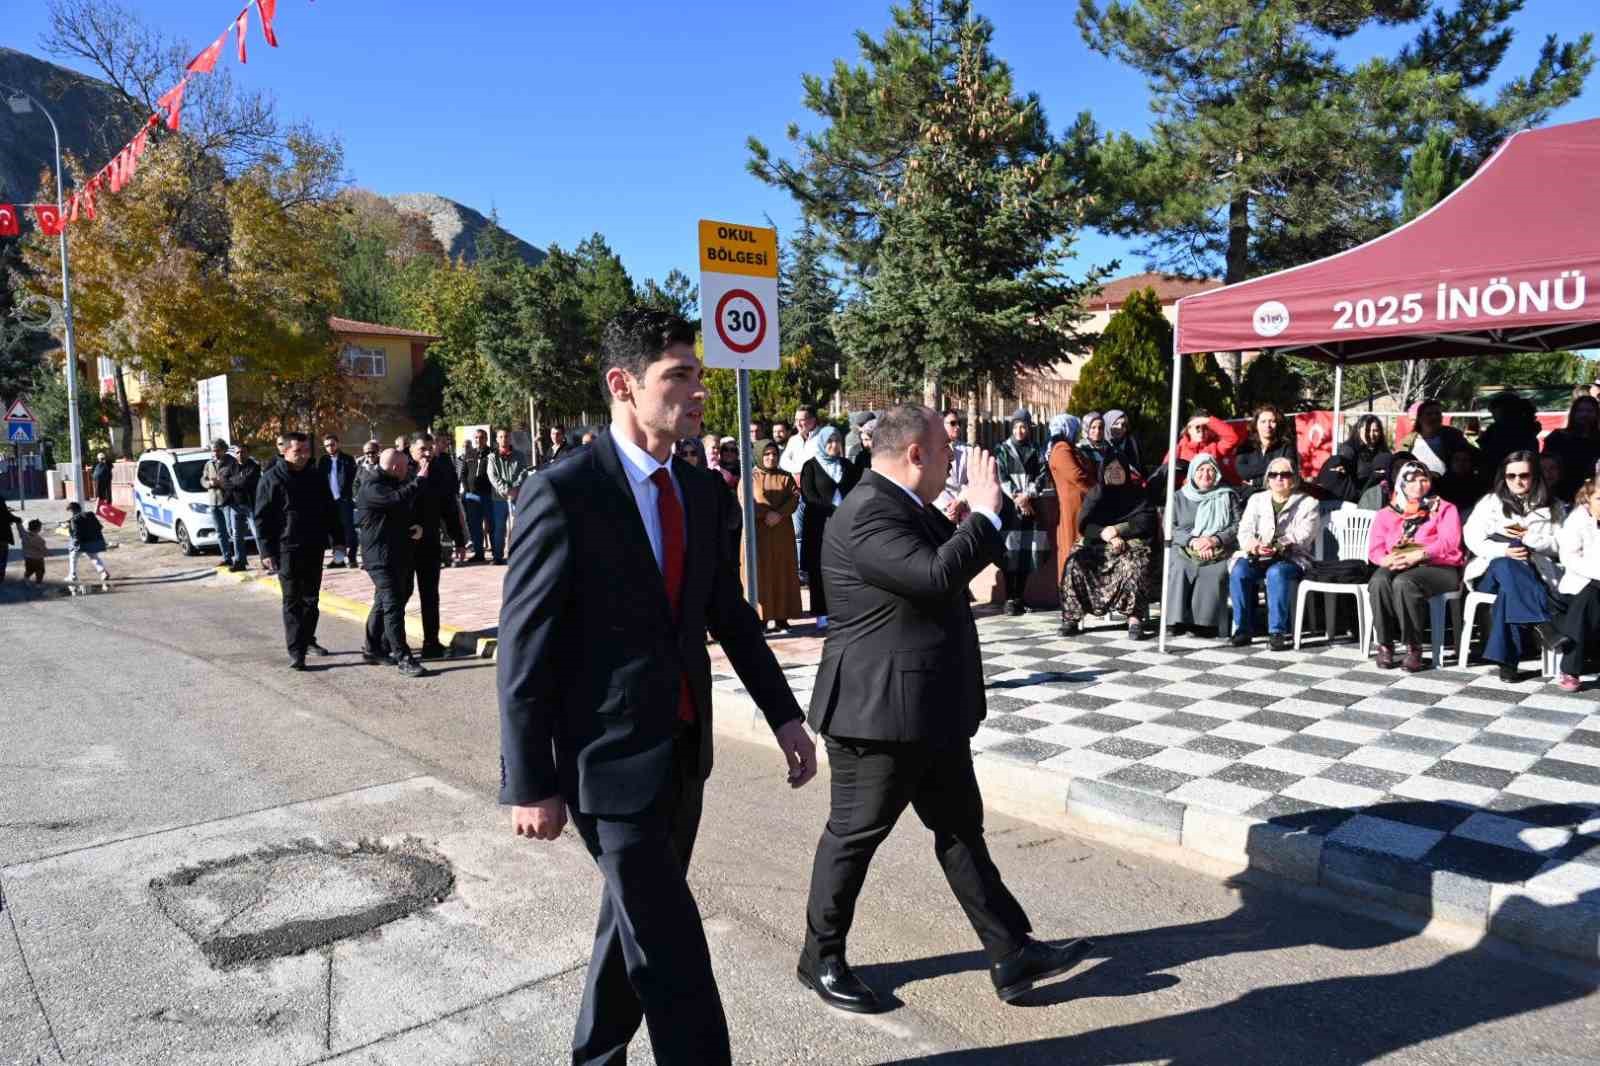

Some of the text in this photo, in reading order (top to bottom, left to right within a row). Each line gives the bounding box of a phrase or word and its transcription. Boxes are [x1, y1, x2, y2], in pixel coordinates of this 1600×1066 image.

[718, 227, 756, 243] OKUL
[708, 247, 767, 265] BÖLGESİ
[1332, 271, 1586, 329] 2025 İNÖNÜ
[727, 310, 756, 332] 30
